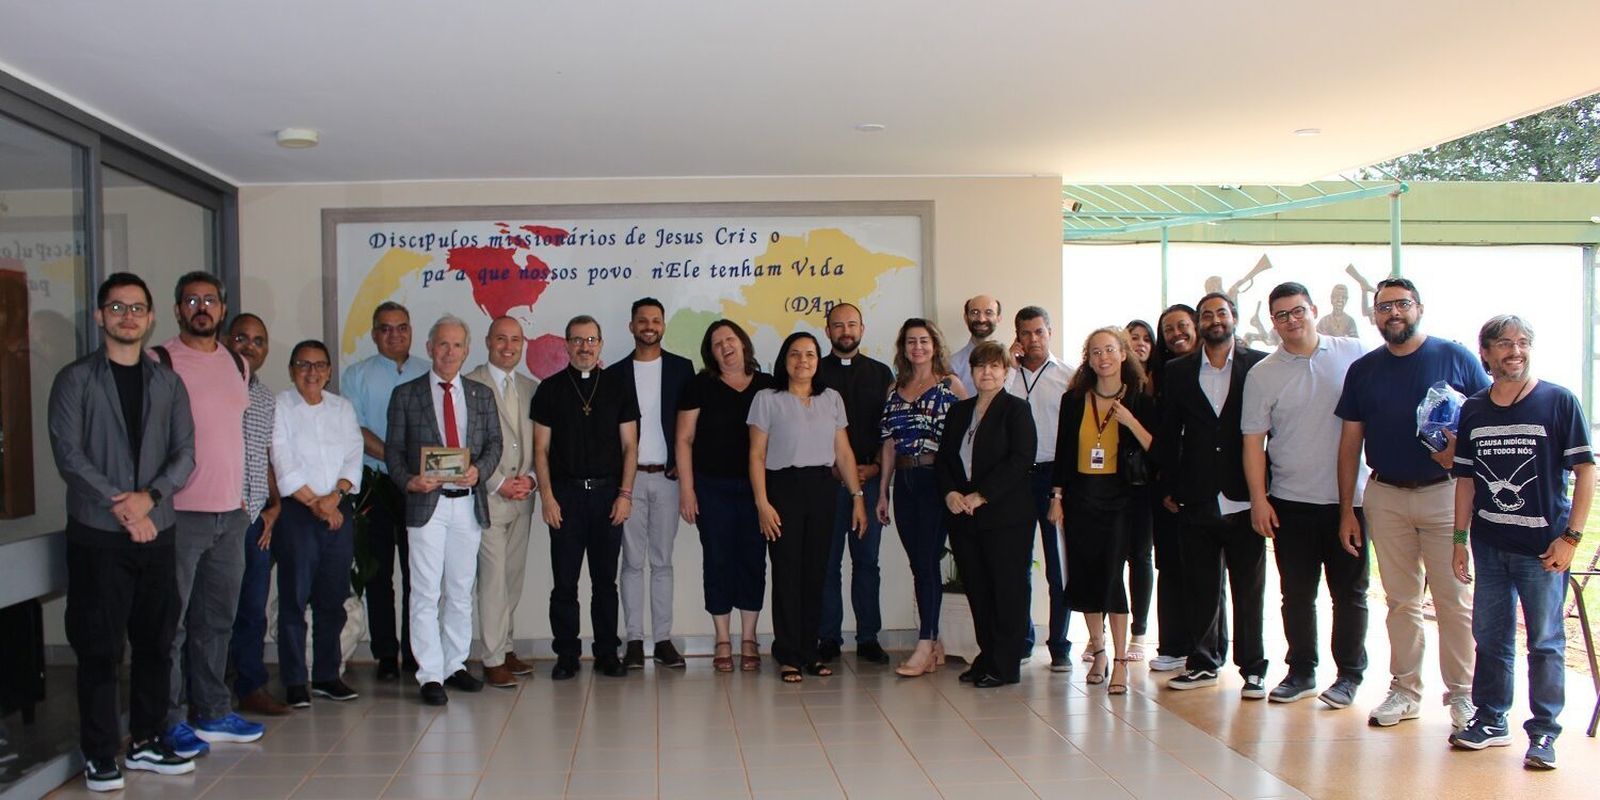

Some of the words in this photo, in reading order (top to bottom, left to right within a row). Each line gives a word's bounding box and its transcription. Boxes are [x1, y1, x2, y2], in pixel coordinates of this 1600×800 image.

[489, 227, 616, 247] missionários
[625, 226, 646, 245] de
[655, 228, 704, 248] Jesus
[478, 267, 510, 285] que
[519, 267, 578, 280] nossos
[710, 259, 782, 278] tenham
[791, 257, 844, 277] Vida
[1479, 439, 1502, 447] CAUSA
[1493, 447, 1516, 455] TODOS
[1517, 447, 1533, 455] NÓS
